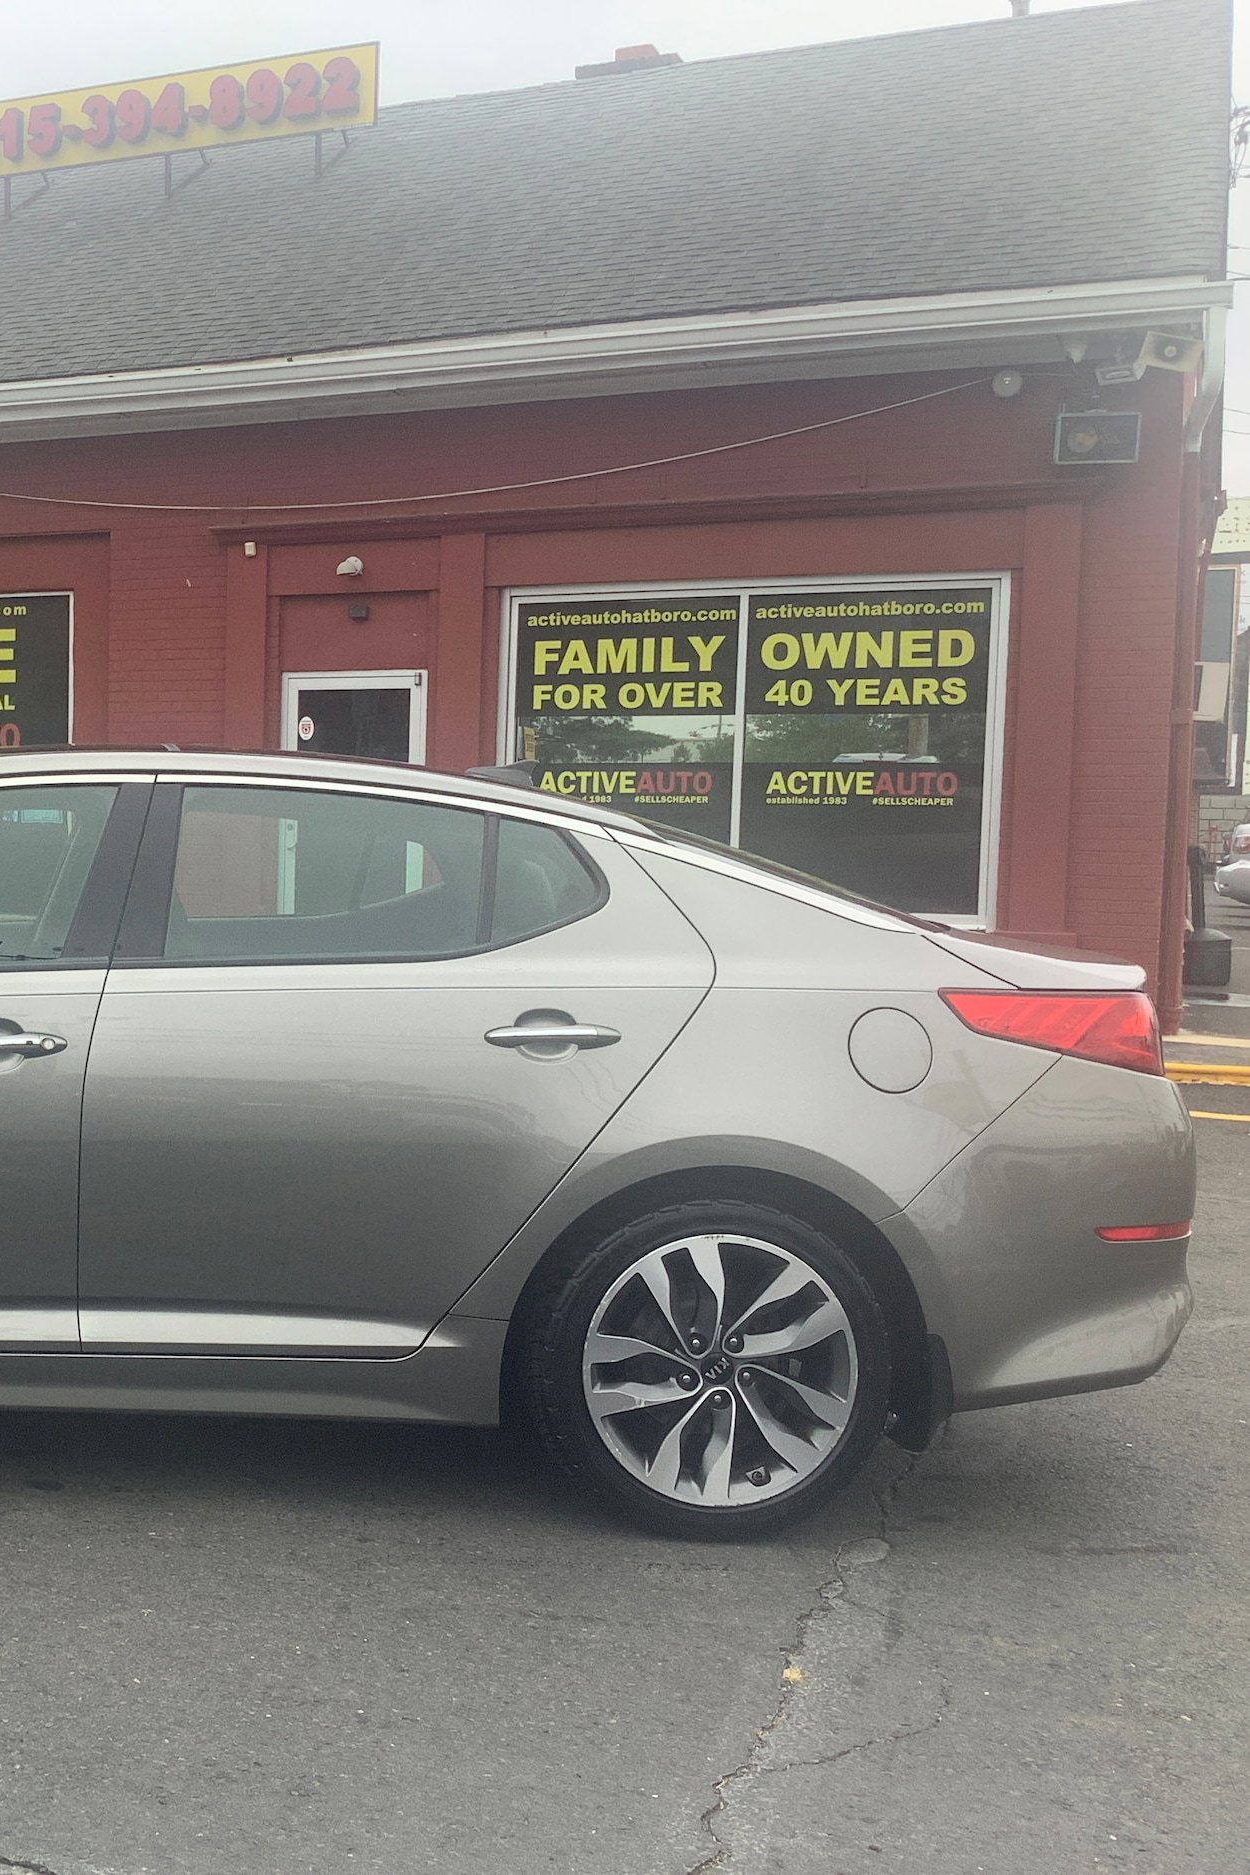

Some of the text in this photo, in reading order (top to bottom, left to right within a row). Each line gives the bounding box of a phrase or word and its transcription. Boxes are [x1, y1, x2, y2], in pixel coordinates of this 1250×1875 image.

[527, 609, 737, 627] activeautohatboro.com
[756, 601, 985, 619] activeautohatboro.com
[533, 635, 726, 676] FAMILY
[760, 629, 976, 671] OWNED
[532, 681, 723, 710] FOR OVER
[764, 677, 967, 707] 40 YEARS
[766, 771, 959, 797] ACTIVEAUTO
[589, 795, 613, 804] 1983
[634, 795, 709, 804] #SELLSCHEAPER
[766, 796, 954, 806] established 1983 #SELLSCHEAPER
